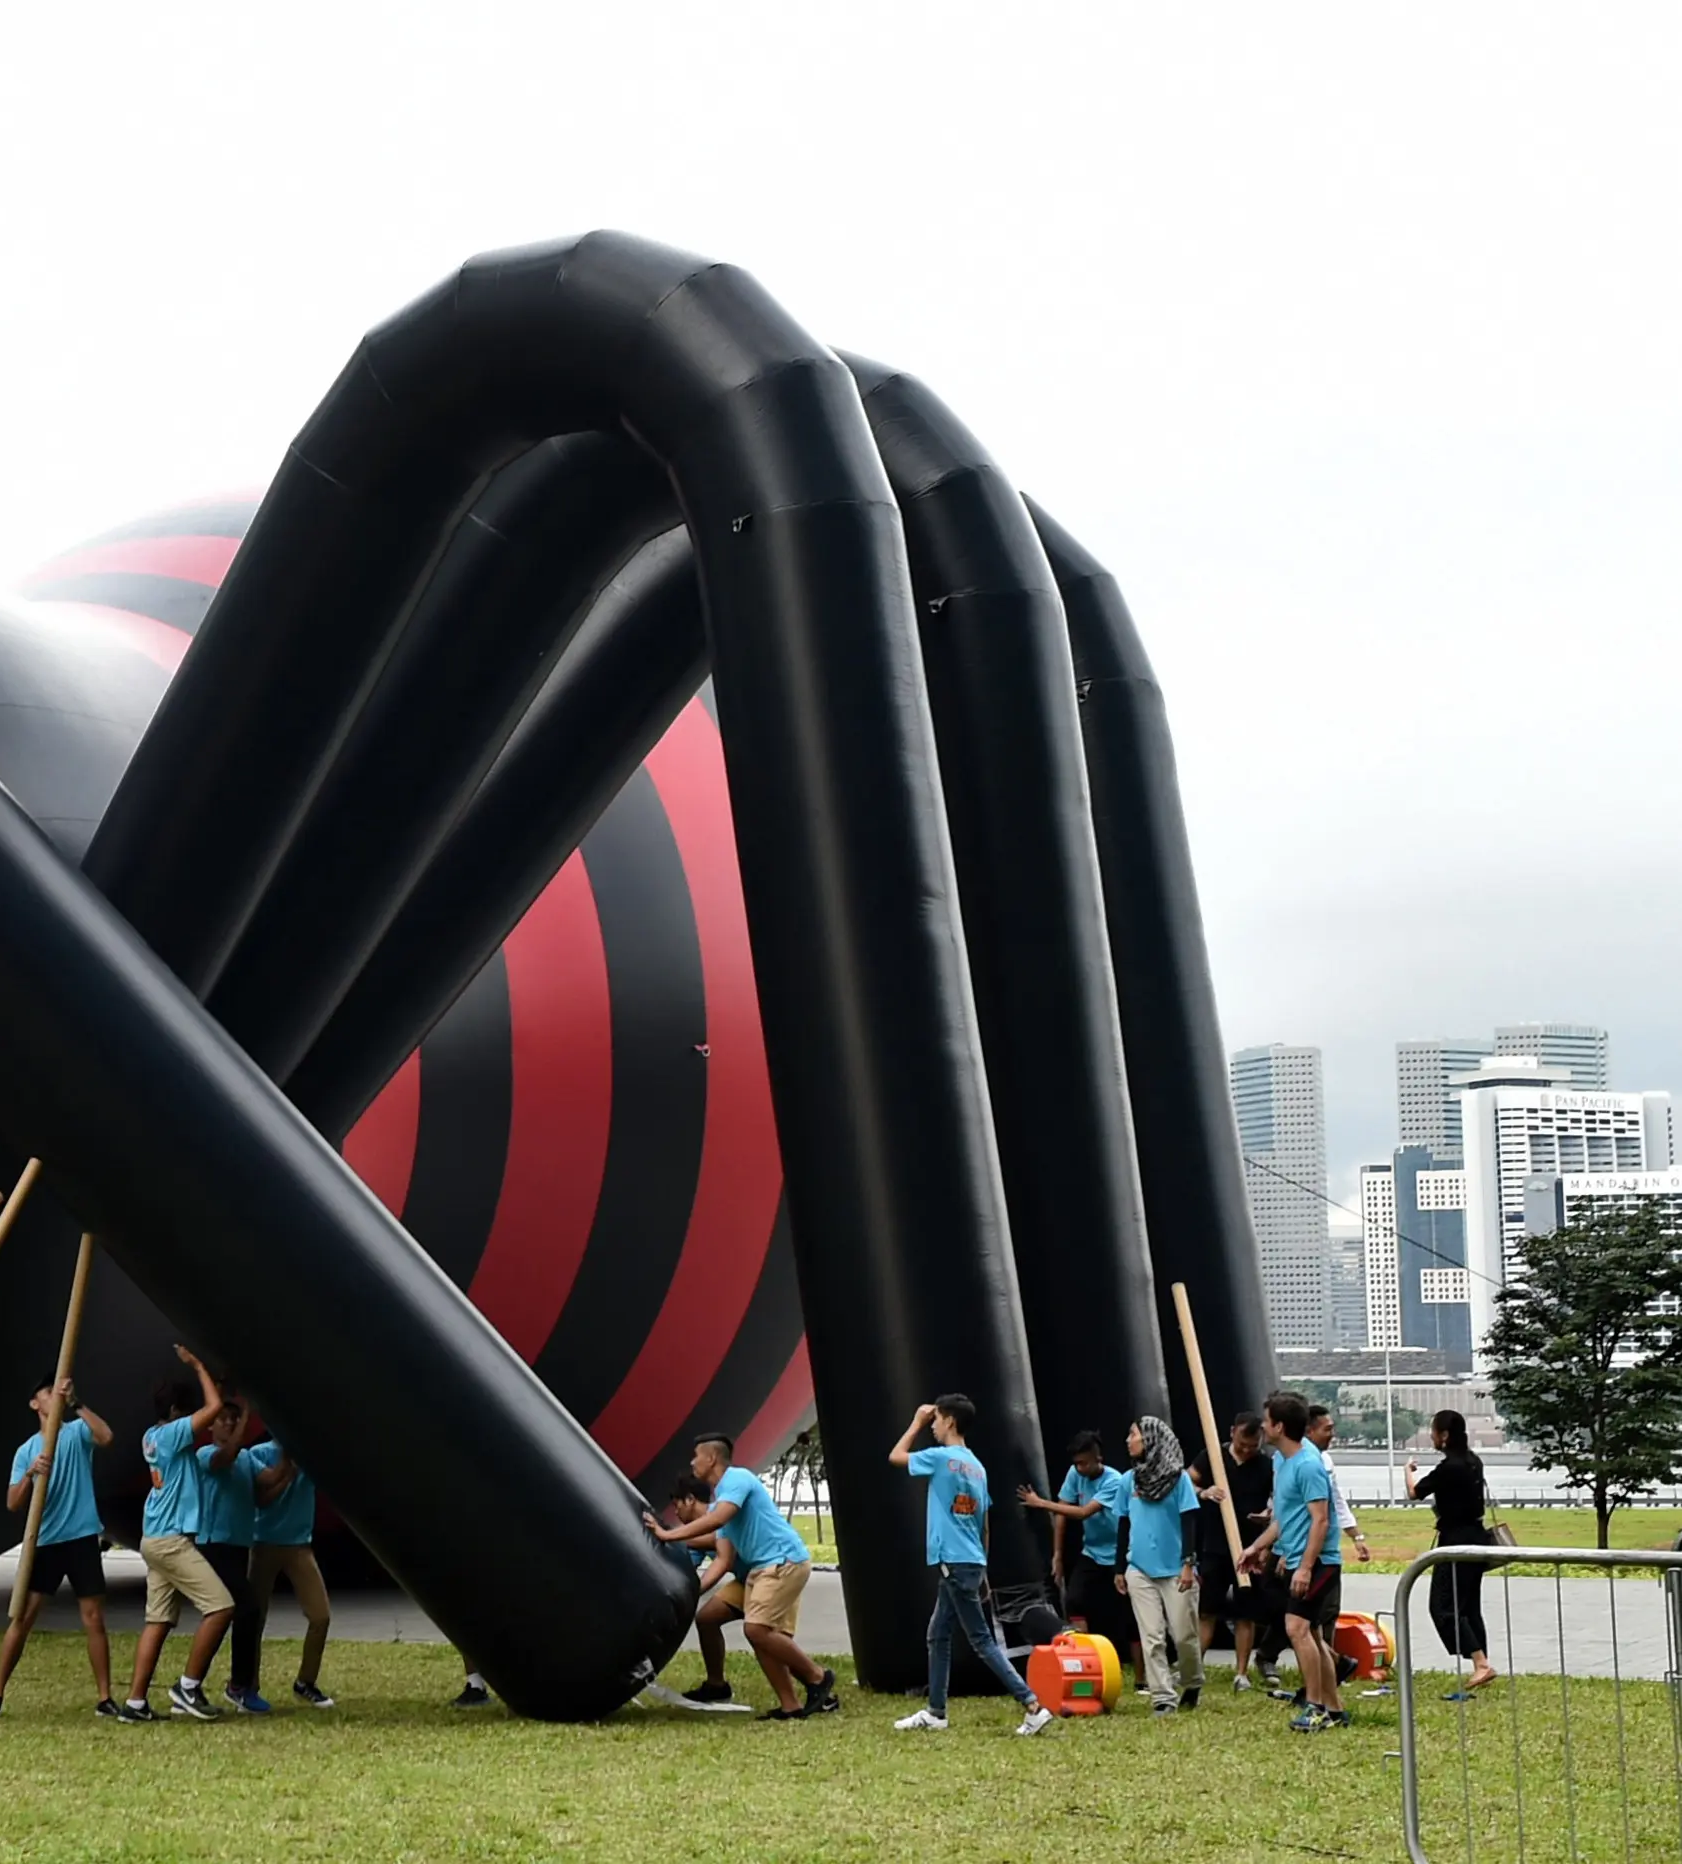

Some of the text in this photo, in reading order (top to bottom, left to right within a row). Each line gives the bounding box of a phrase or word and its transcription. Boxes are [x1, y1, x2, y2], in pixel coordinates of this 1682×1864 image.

[1555, 1095, 1625, 1109] PAN PACIFIC
[1570, 1178, 1660, 1189] MANDARIN
